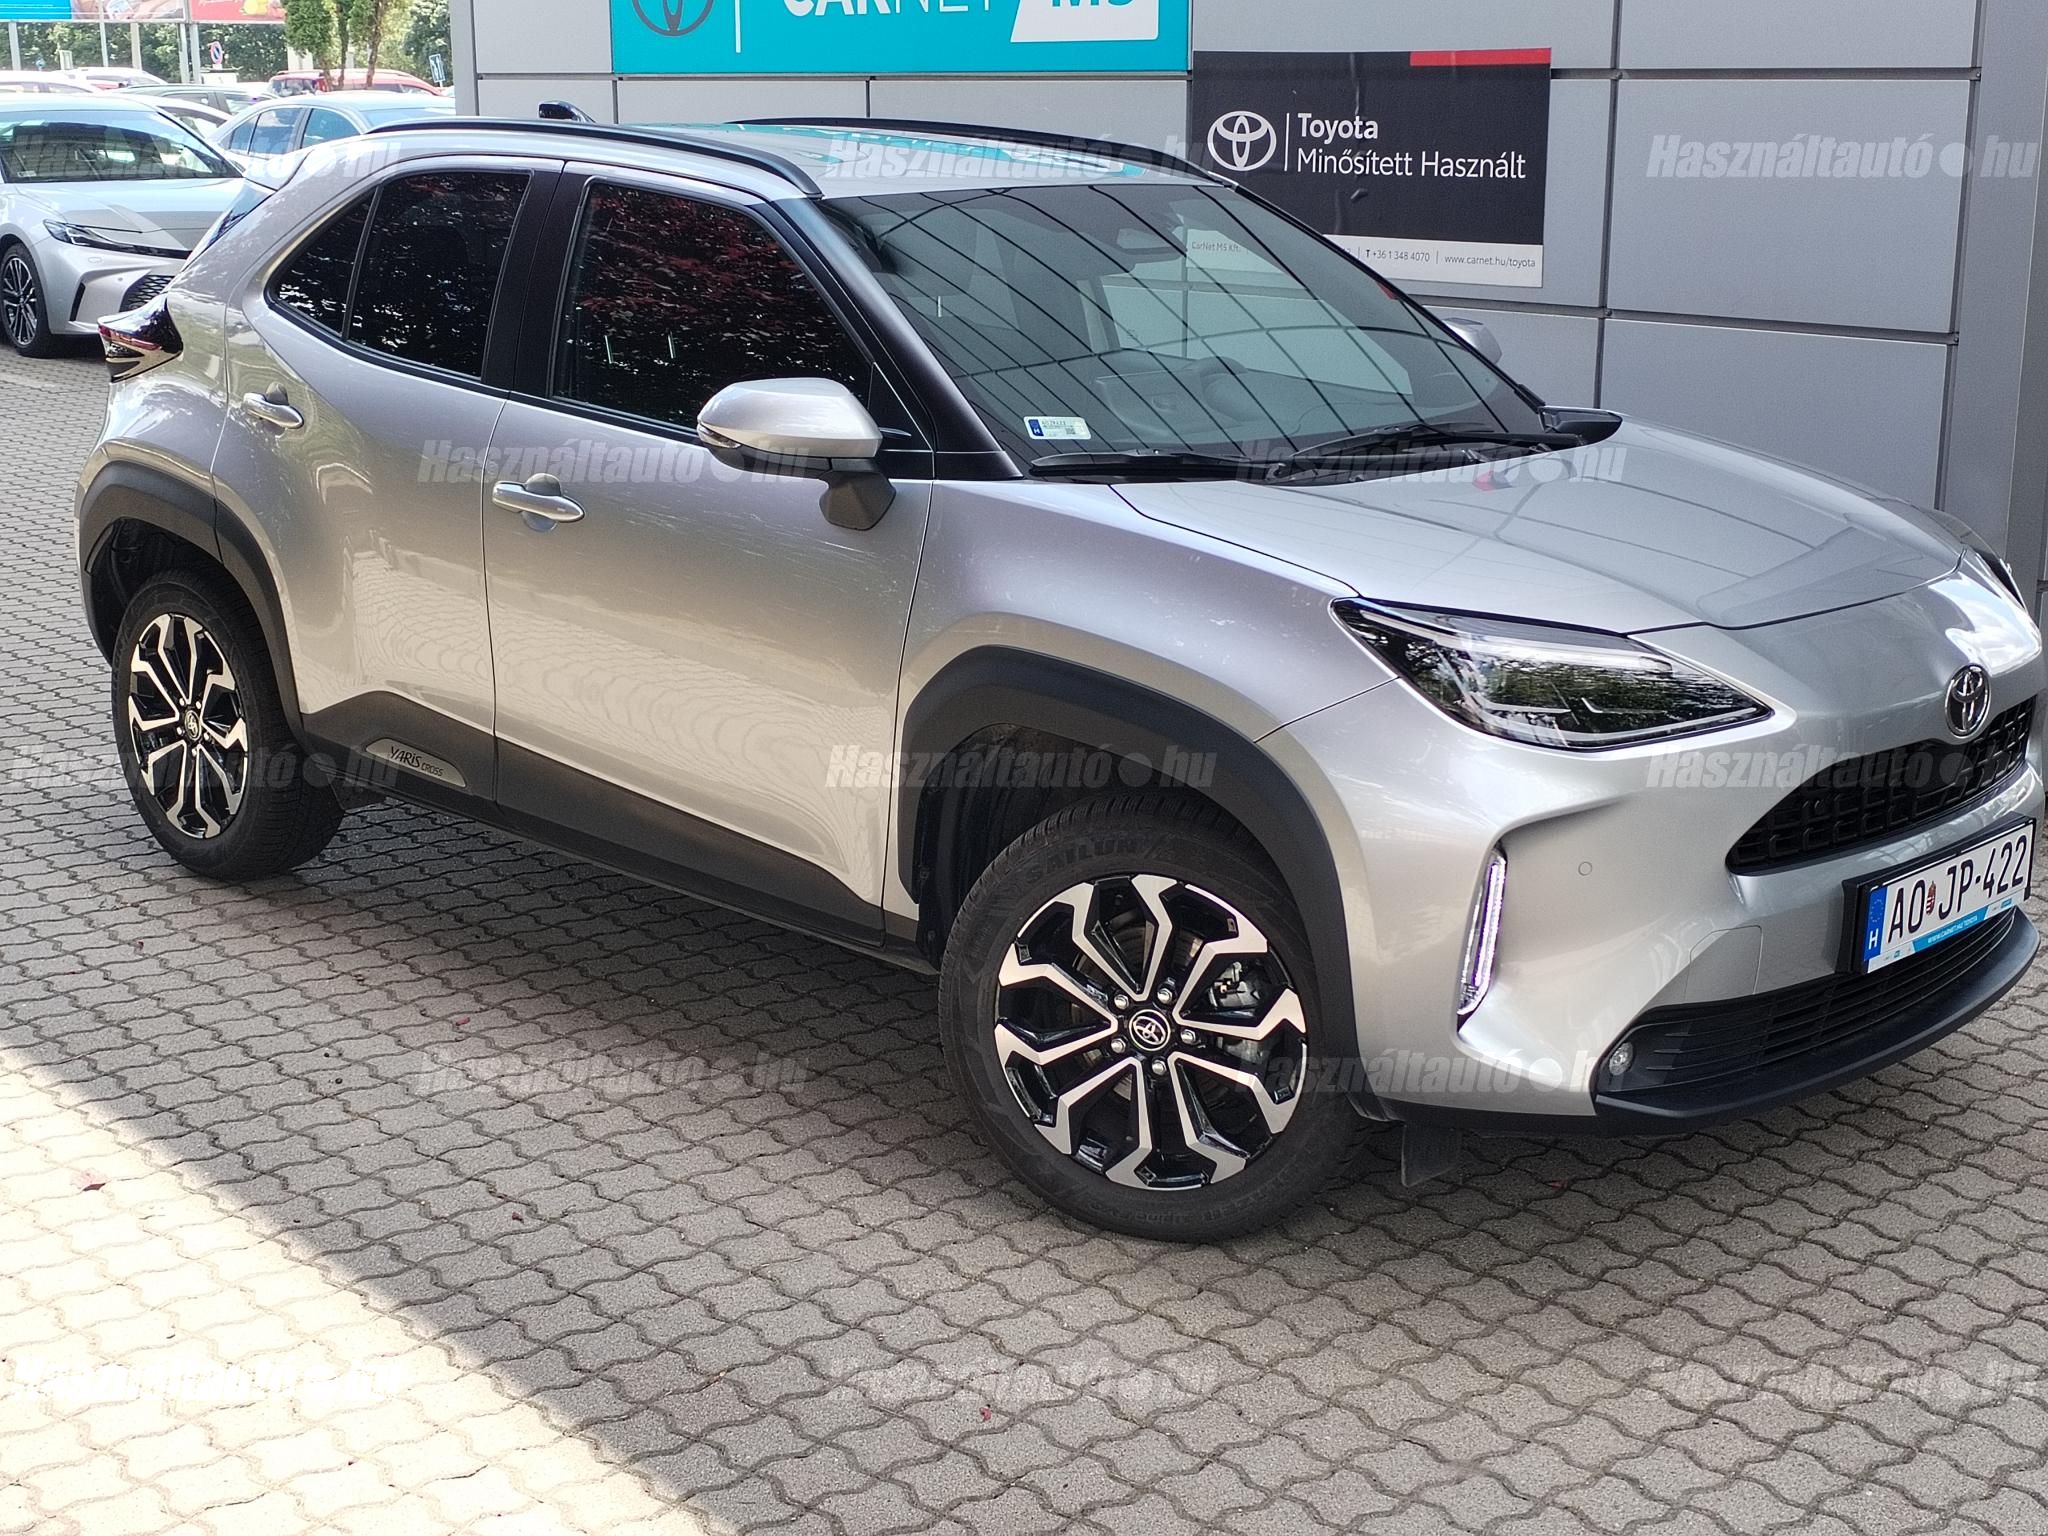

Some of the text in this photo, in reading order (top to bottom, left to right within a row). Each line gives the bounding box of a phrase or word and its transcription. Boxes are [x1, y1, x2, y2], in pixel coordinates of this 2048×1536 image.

[1297, 112, 1379, 145] Toyota
[1297, 148, 1527, 180] Minősített Használt
[1410, 251, 1431, 263] 4070
[1445, 254, 1536, 268] www.carnet.hu/toyota
[421, 762, 444, 777] CROSS
